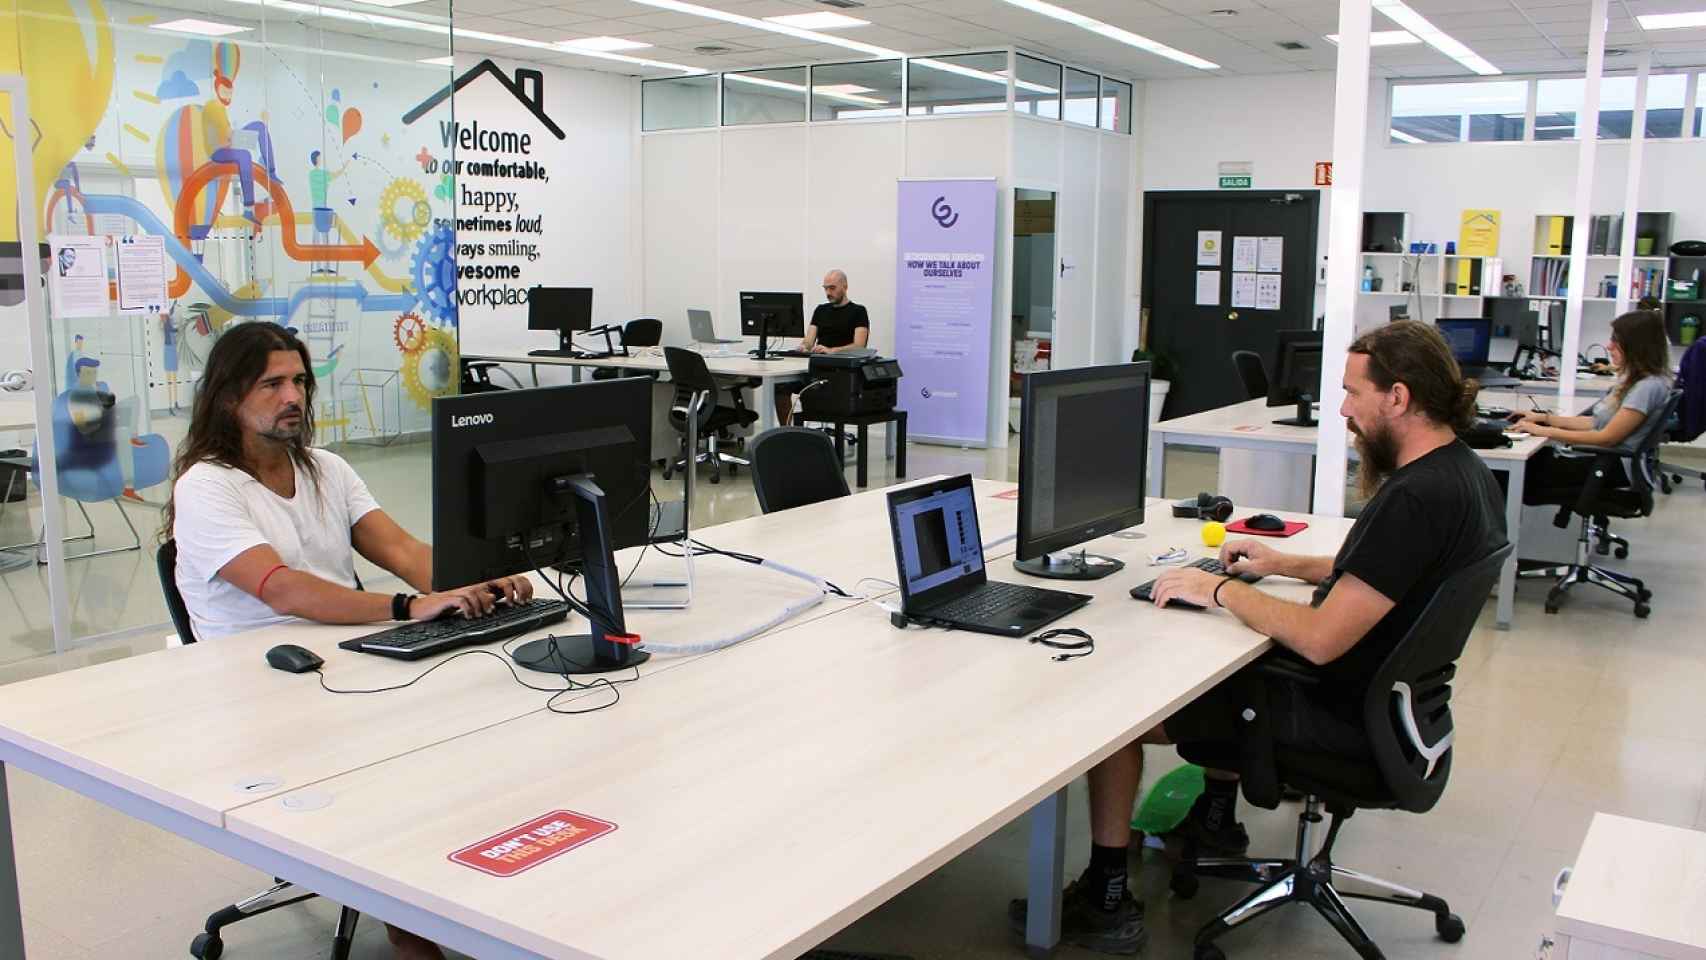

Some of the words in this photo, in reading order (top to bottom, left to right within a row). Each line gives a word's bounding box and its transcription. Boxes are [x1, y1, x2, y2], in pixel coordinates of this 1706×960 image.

[440, 120, 532, 154] Welcome
[467, 158, 549, 183] comfortable,
[1222, 178, 1249, 186] SALIDA
[461, 184, 519, 212] happy,
[515, 214, 543, 235] loud,
[488, 239, 541, 262] smiling,
[907, 261, 924, 269] HOW
[925, 261, 938, 269] WE
[939, 260, 955, 269] TALK
[957, 261, 981, 269] ABOUT
[923, 269, 962, 278] OURSELVES
[451, 413, 494, 428] Lenovo
[480, 833, 537, 859] DON'T
[530, 820, 572, 836] USE
[495, 844, 543, 863] THIS
[536, 825, 588, 847] DESK
